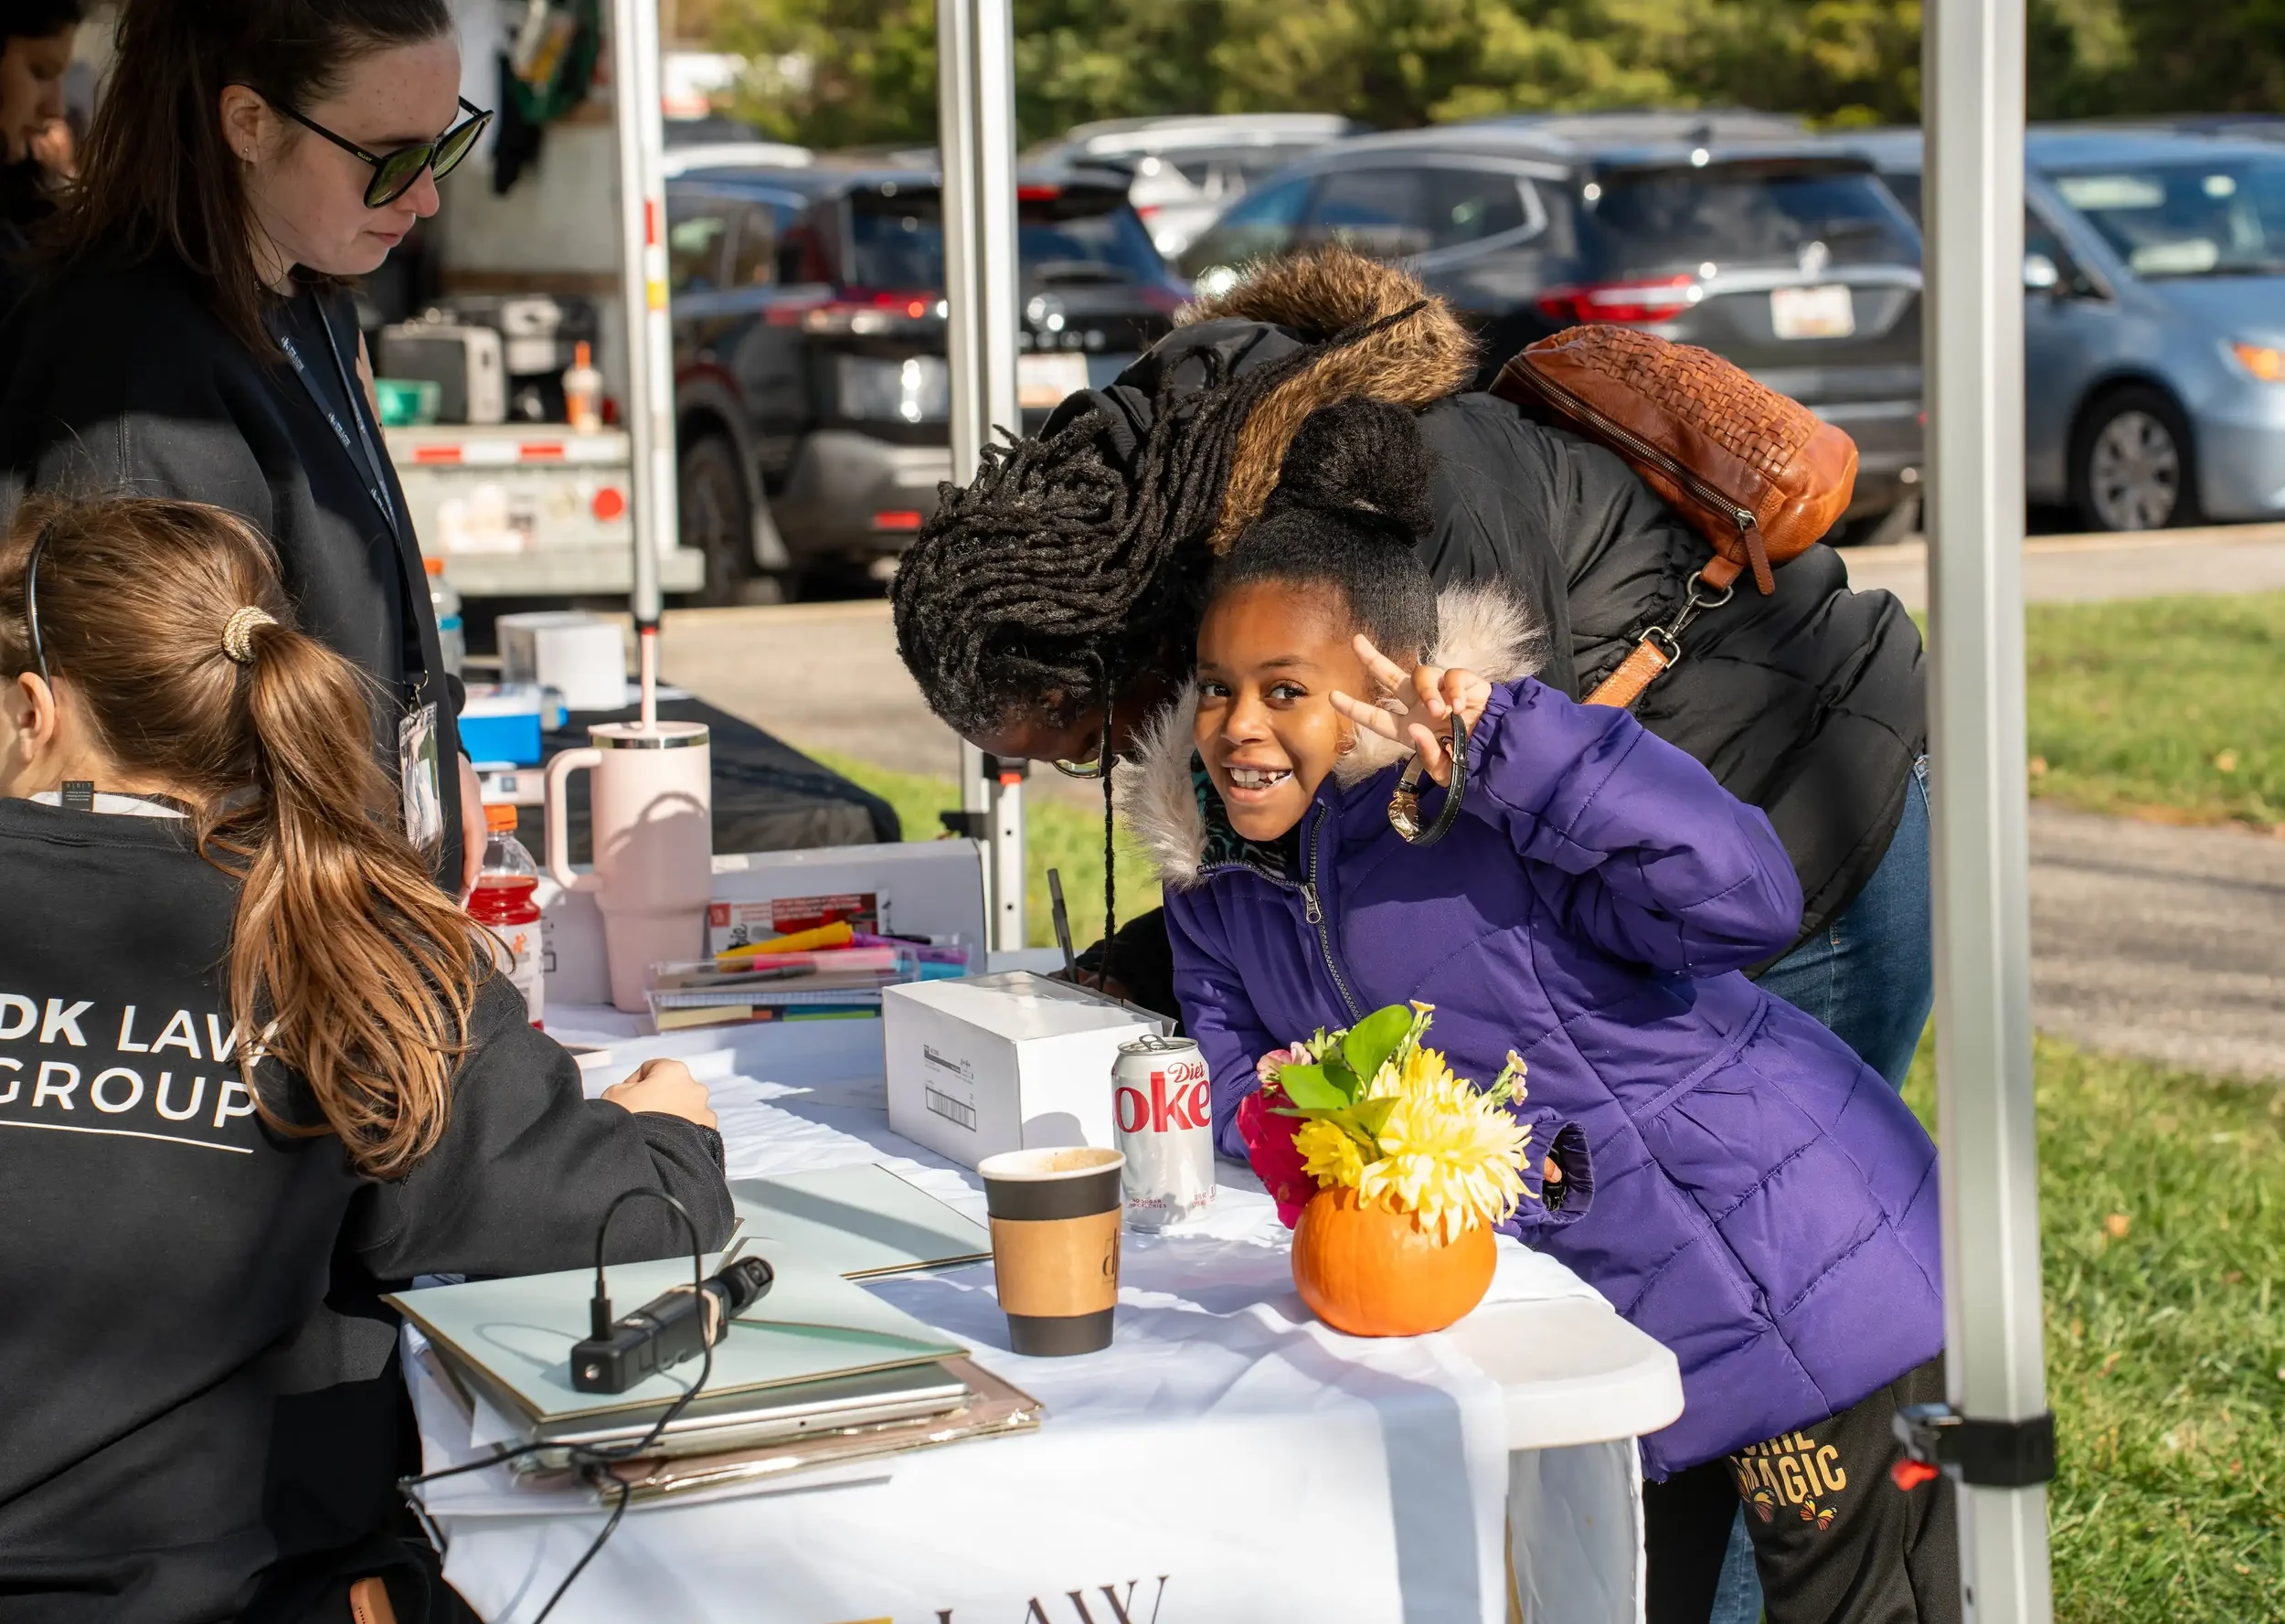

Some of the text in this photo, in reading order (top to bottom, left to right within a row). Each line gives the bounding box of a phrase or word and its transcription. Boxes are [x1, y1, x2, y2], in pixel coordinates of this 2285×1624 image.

[0, 992, 278, 1067] DK LAW
[0, 1056, 260, 1128] GROUP
[1113, 1070, 1211, 1133] oke
[1167, 1061, 1206, 1083] Diet
